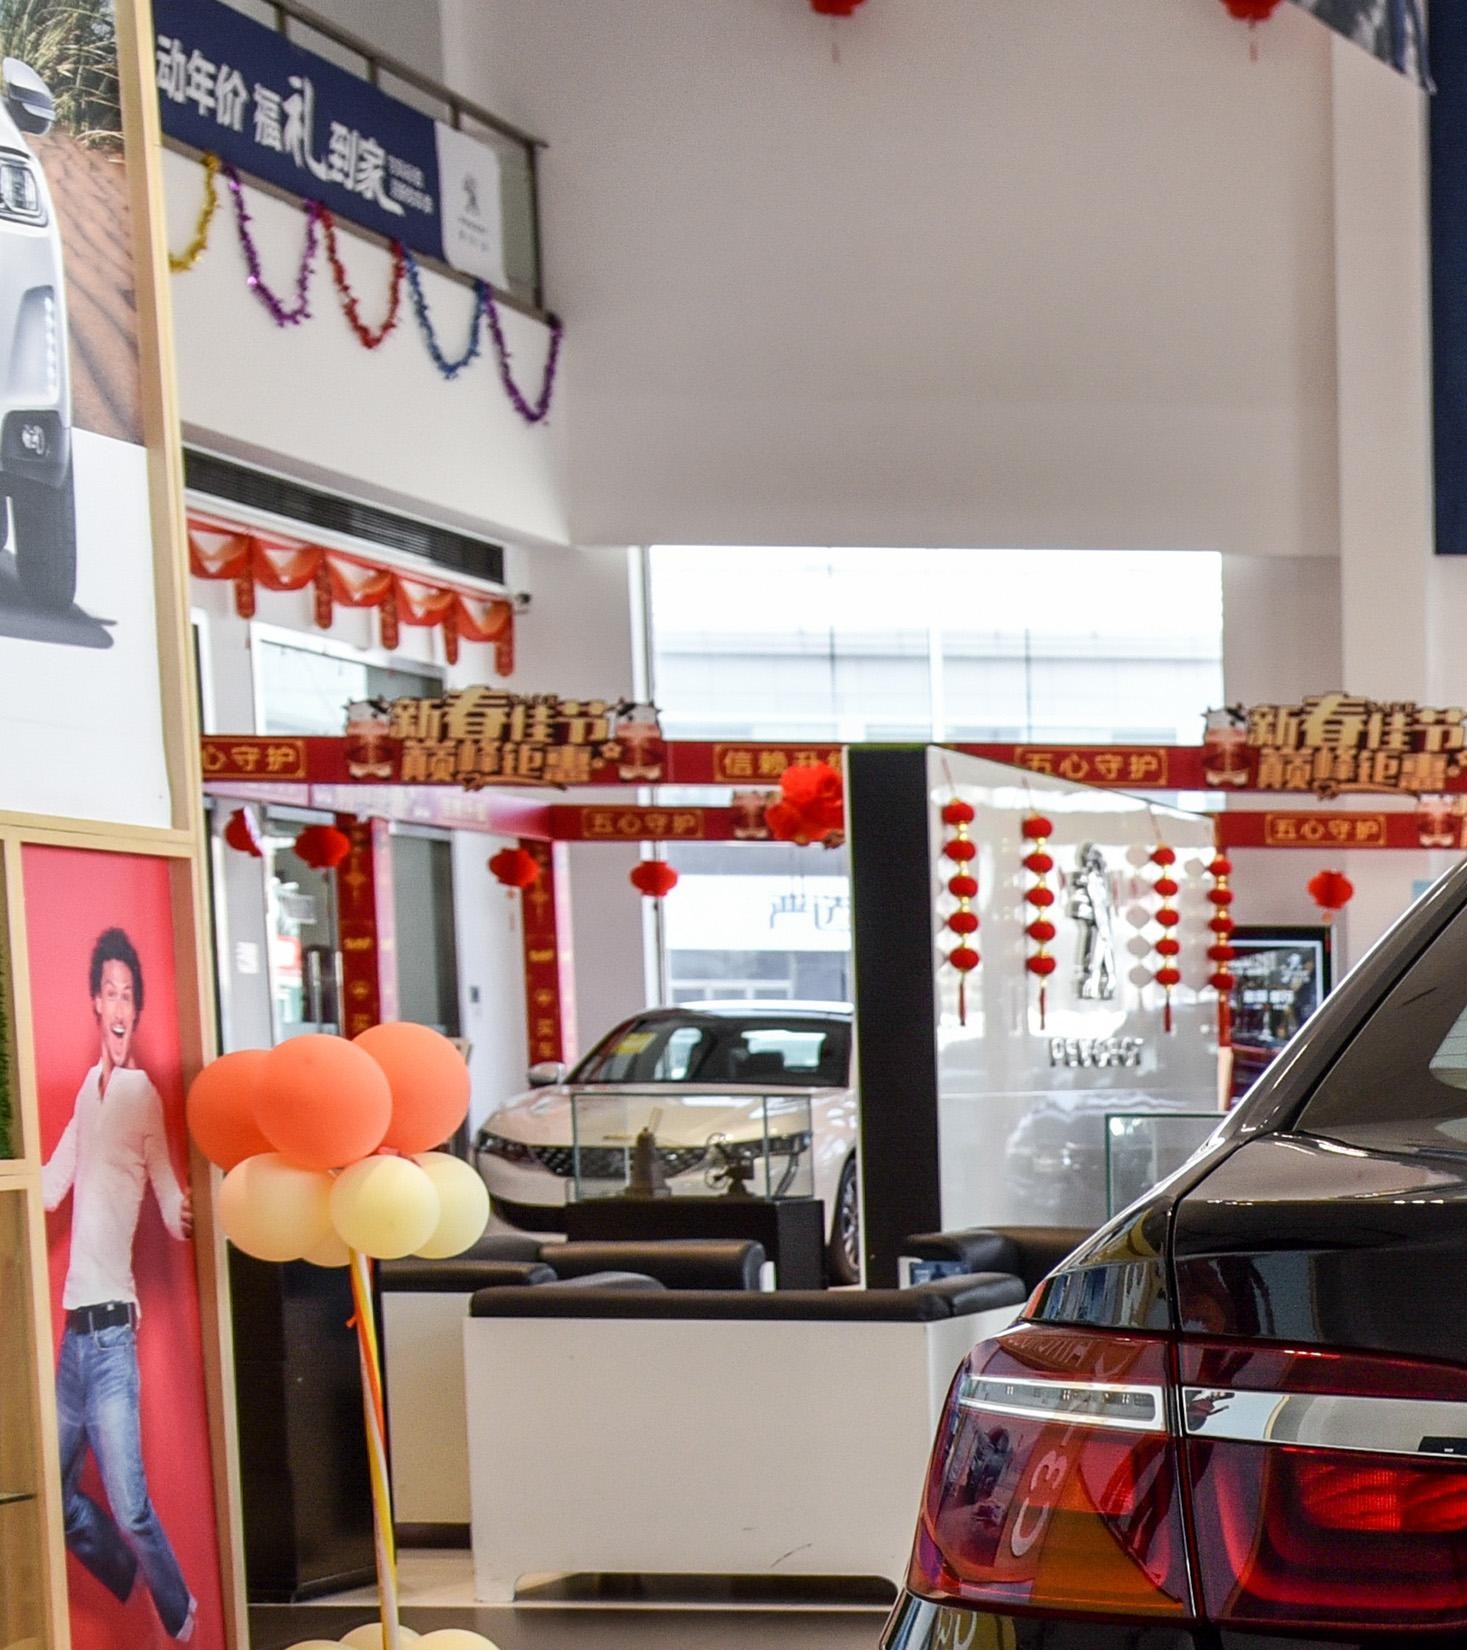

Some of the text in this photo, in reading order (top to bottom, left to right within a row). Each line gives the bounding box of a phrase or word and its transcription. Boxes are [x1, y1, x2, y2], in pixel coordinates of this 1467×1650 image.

[389, 685, 608, 745] 新春佳节
[1248, 691, 1466, 750] 新春佳节
[1026, 751, 1162, 781] 五心守护
[1272, 817, 1381, 842] 五心守护
